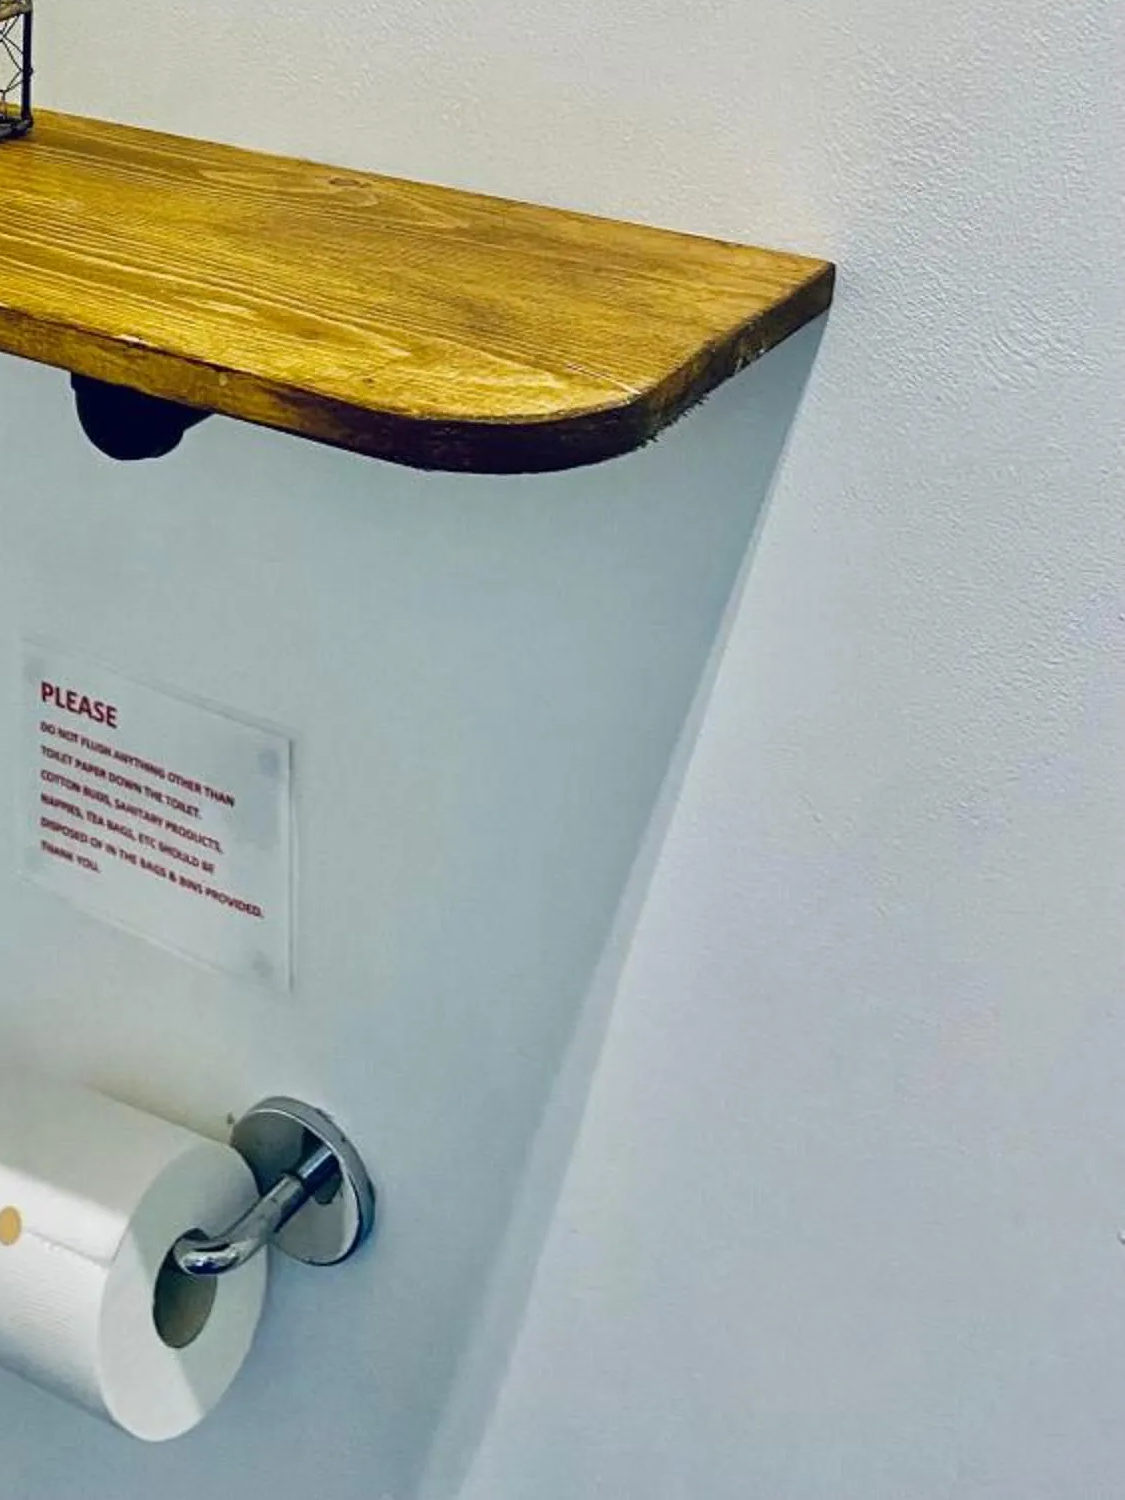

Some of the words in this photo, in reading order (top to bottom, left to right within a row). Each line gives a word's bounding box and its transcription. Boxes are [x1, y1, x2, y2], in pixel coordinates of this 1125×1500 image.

[40, 681, 117, 729] PLEASE
[40, 721, 55, 735] DO
[58, 728, 78, 742] NOT
[81, 737, 112, 756] FLUSH
[114, 750, 165, 779] ANYTHING
[167, 771, 201, 795] OTHER
[203, 786, 235, 808] THAN
[40, 745, 73, 765] TOILET
[75, 758, 106, 777] PAPER
[109, 772, 142, 793] DOWN
[144, 786, 163, 803] THE
[165, 795, 202, 820] TOILET.
[40, 770, 81, 792] COTTON
[115, 799, 162, 828] SANITARY
[40, 817, 88, 843] DISPOSED
[90, 838, 103, 849] OF
[105, 844, 117, 856] IN
[120, 849, 137, 865] THE
[140, 858, 167, 878] BAGS
[169, 871, 177, 883] &
[179, 876, 203, 894] BINS
[205, 888, 265, 918] PROVIDED.
[41, 841, 73, 862] THANK
[86, 811, 104, 826] TEA
[139, 833, 156, 849] ETC
[159, 842, 200, 867] SHOULD
[202, 861, 215, 874] BE
